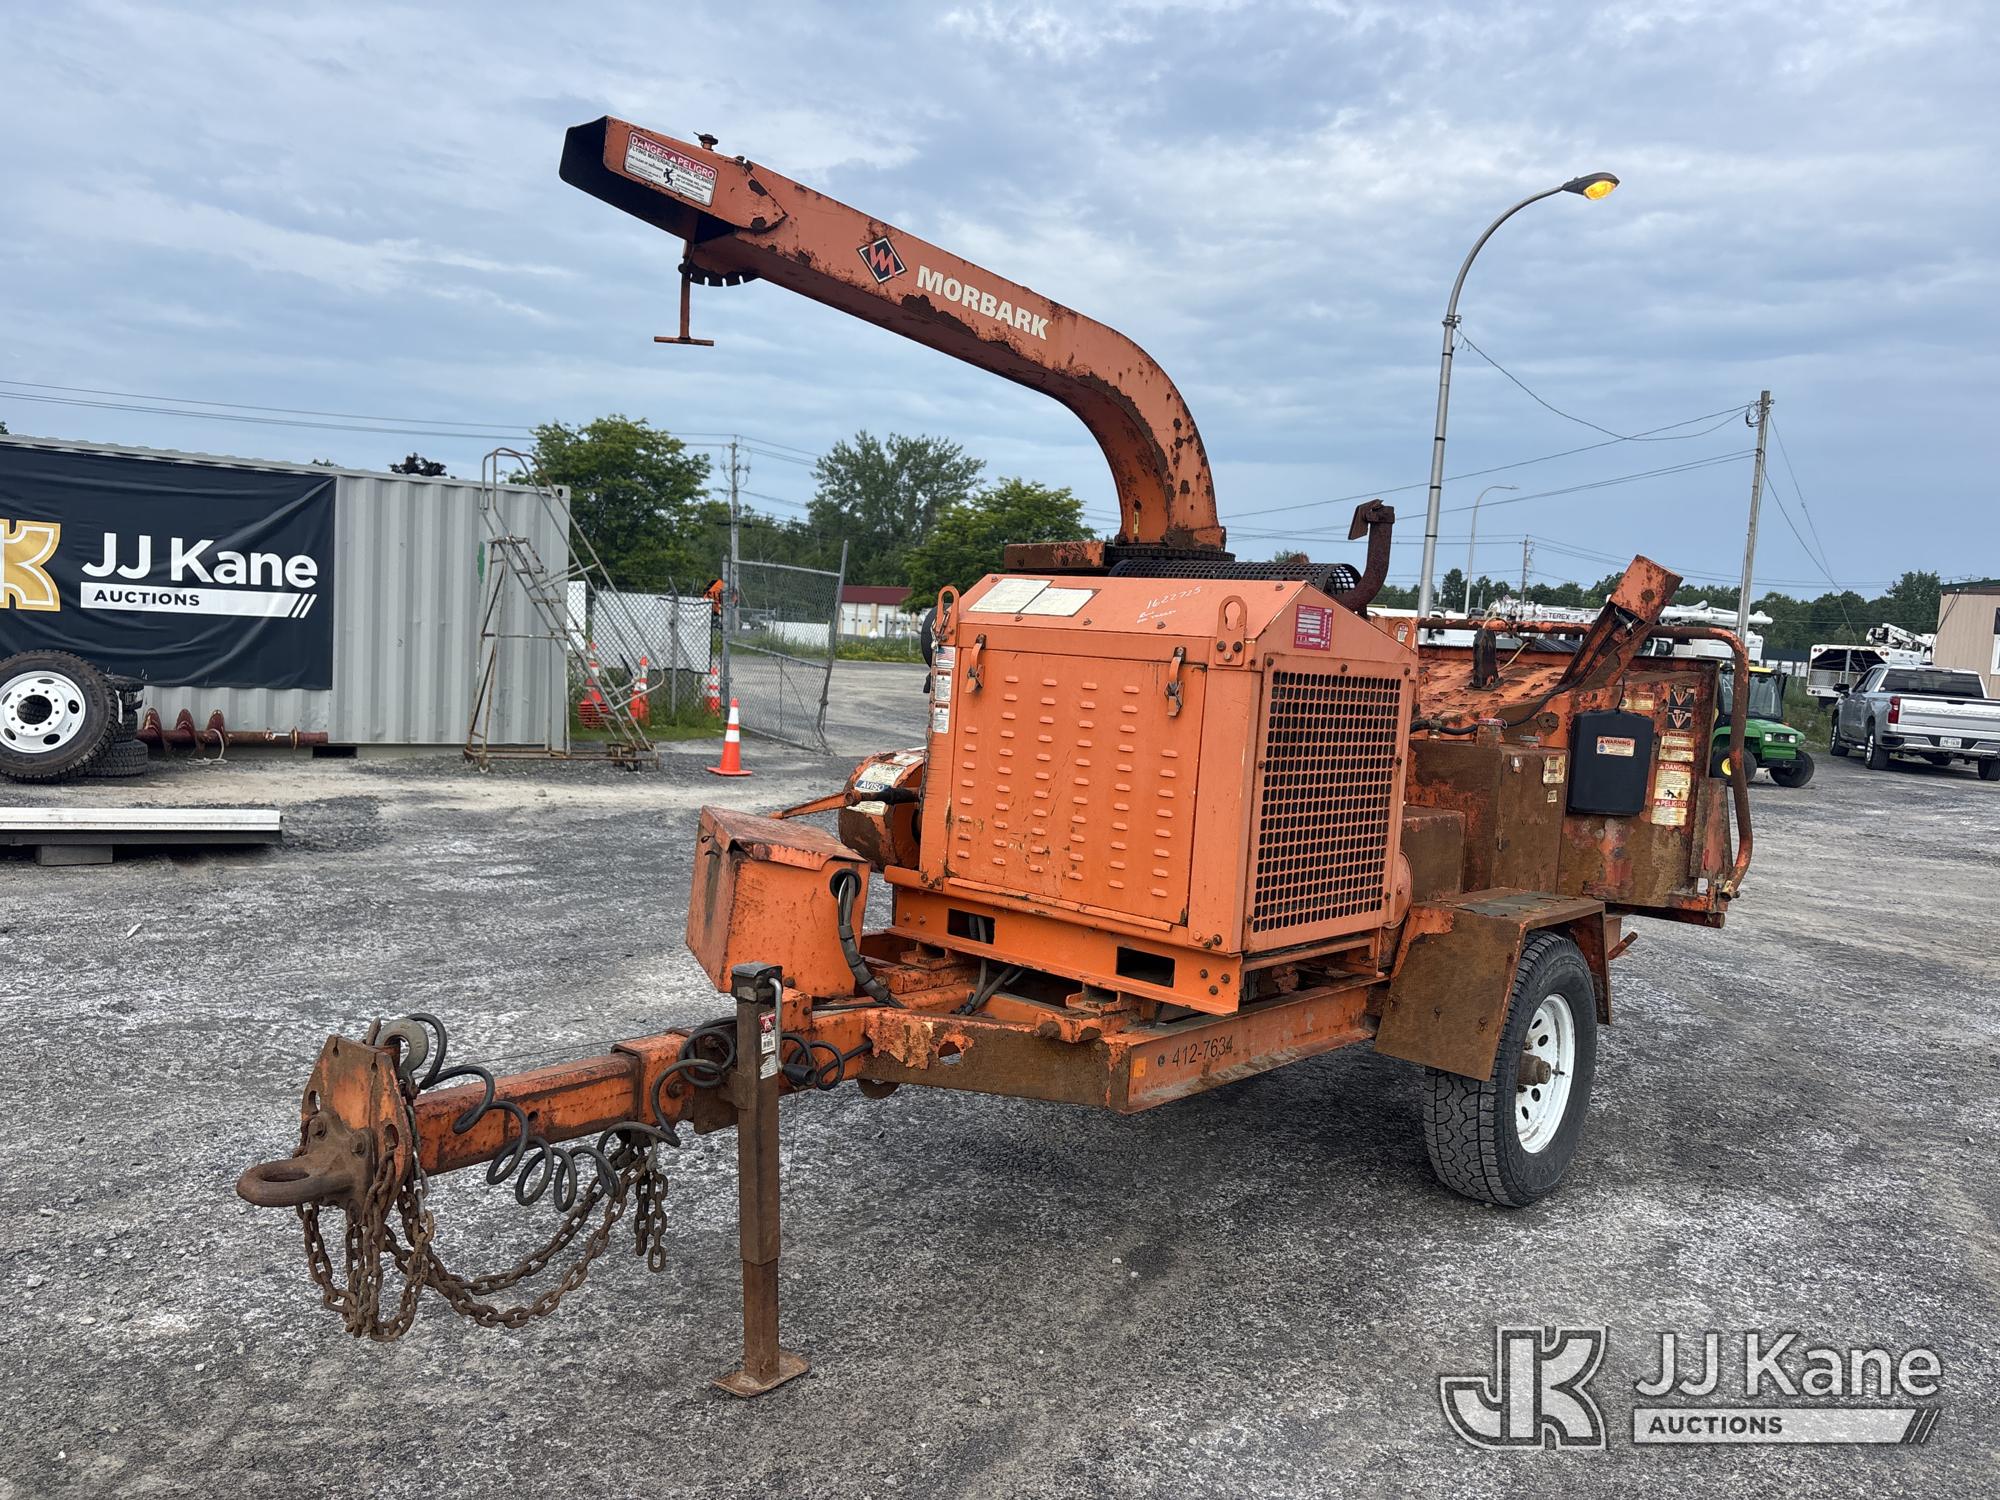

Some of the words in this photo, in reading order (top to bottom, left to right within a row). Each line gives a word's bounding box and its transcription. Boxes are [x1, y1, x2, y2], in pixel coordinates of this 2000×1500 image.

[630, 135, 668, 159] DANGER
[677, 157, 714, 179] PELIGRO
[917, 265, 1049, 340] MORBARK
[81, 532, 152, 580] JJ
[170, 537, 319, 589] Kane
[94, 589, 200, 607] AUCTIONS
[1664, 763, 1690, 772] DANGER
[1660, 800, 1687, 808] PELIGRO
[1172, 1035, 1233, 1067] 412-7634
